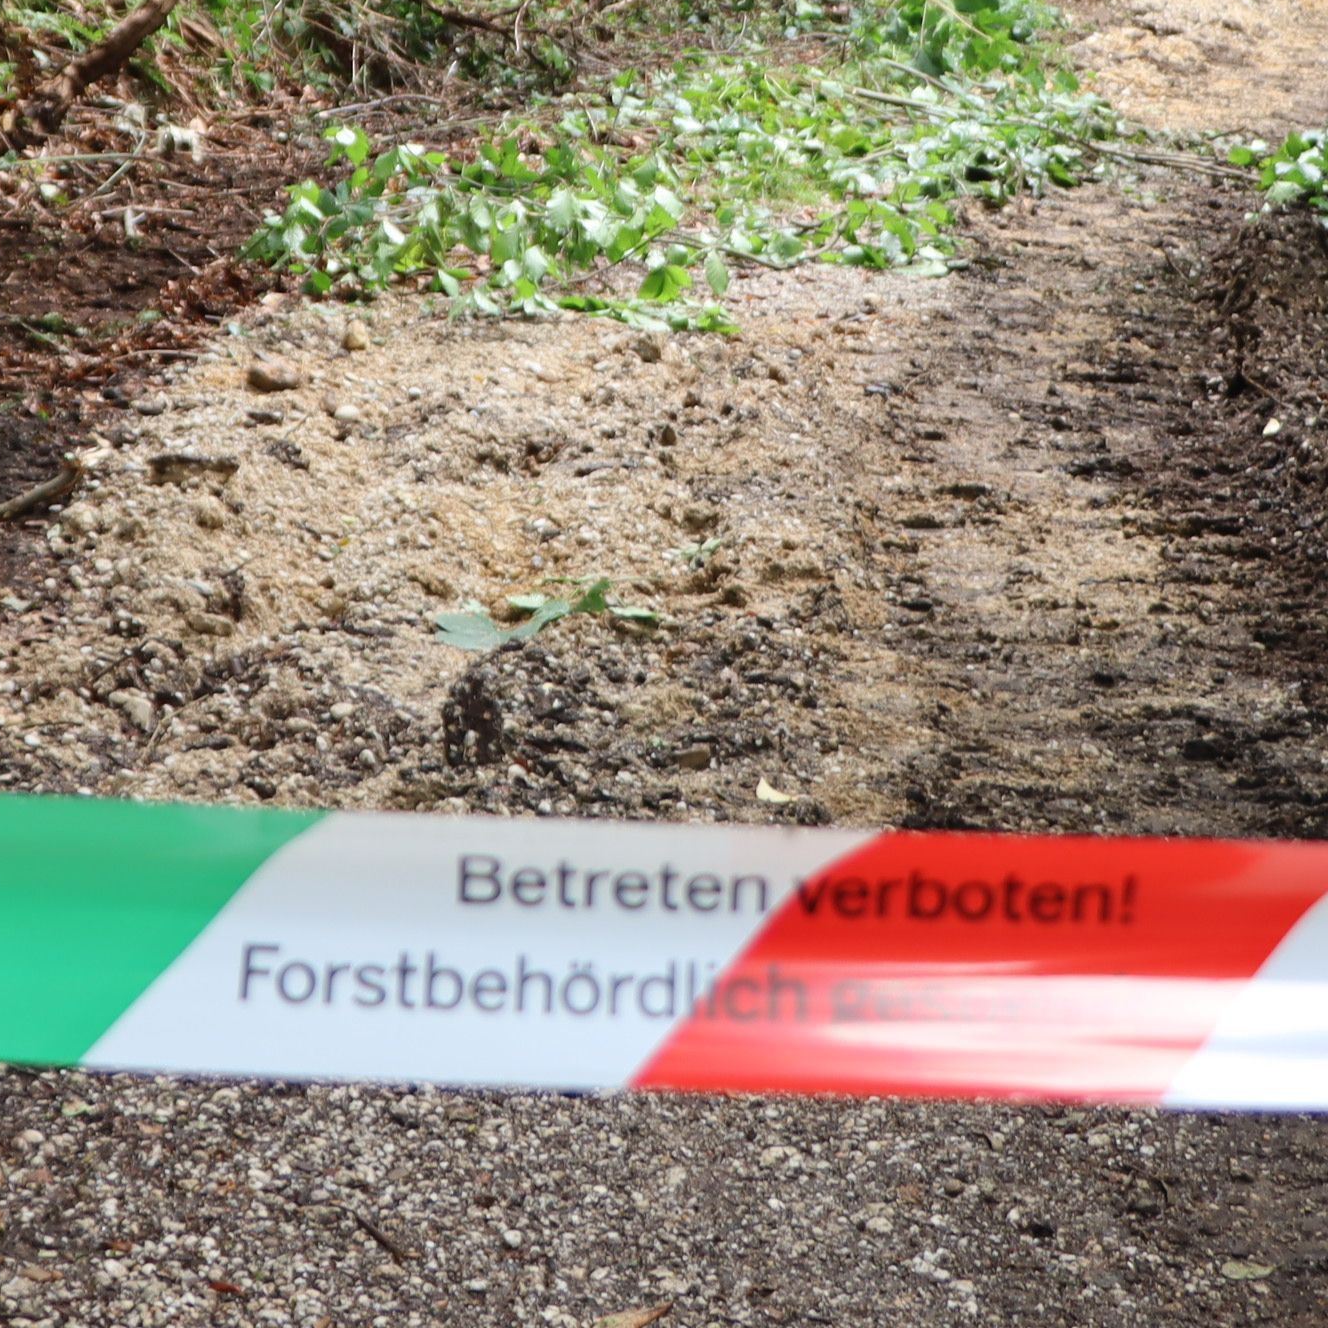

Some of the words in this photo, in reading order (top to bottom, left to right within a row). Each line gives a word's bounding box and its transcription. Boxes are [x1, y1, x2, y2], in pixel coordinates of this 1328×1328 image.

[457, 853, 768, 913] Betreten
[796, 869, 1140, 925] verboten!
[238, 943, 807, 1023] Forstbehördlich
